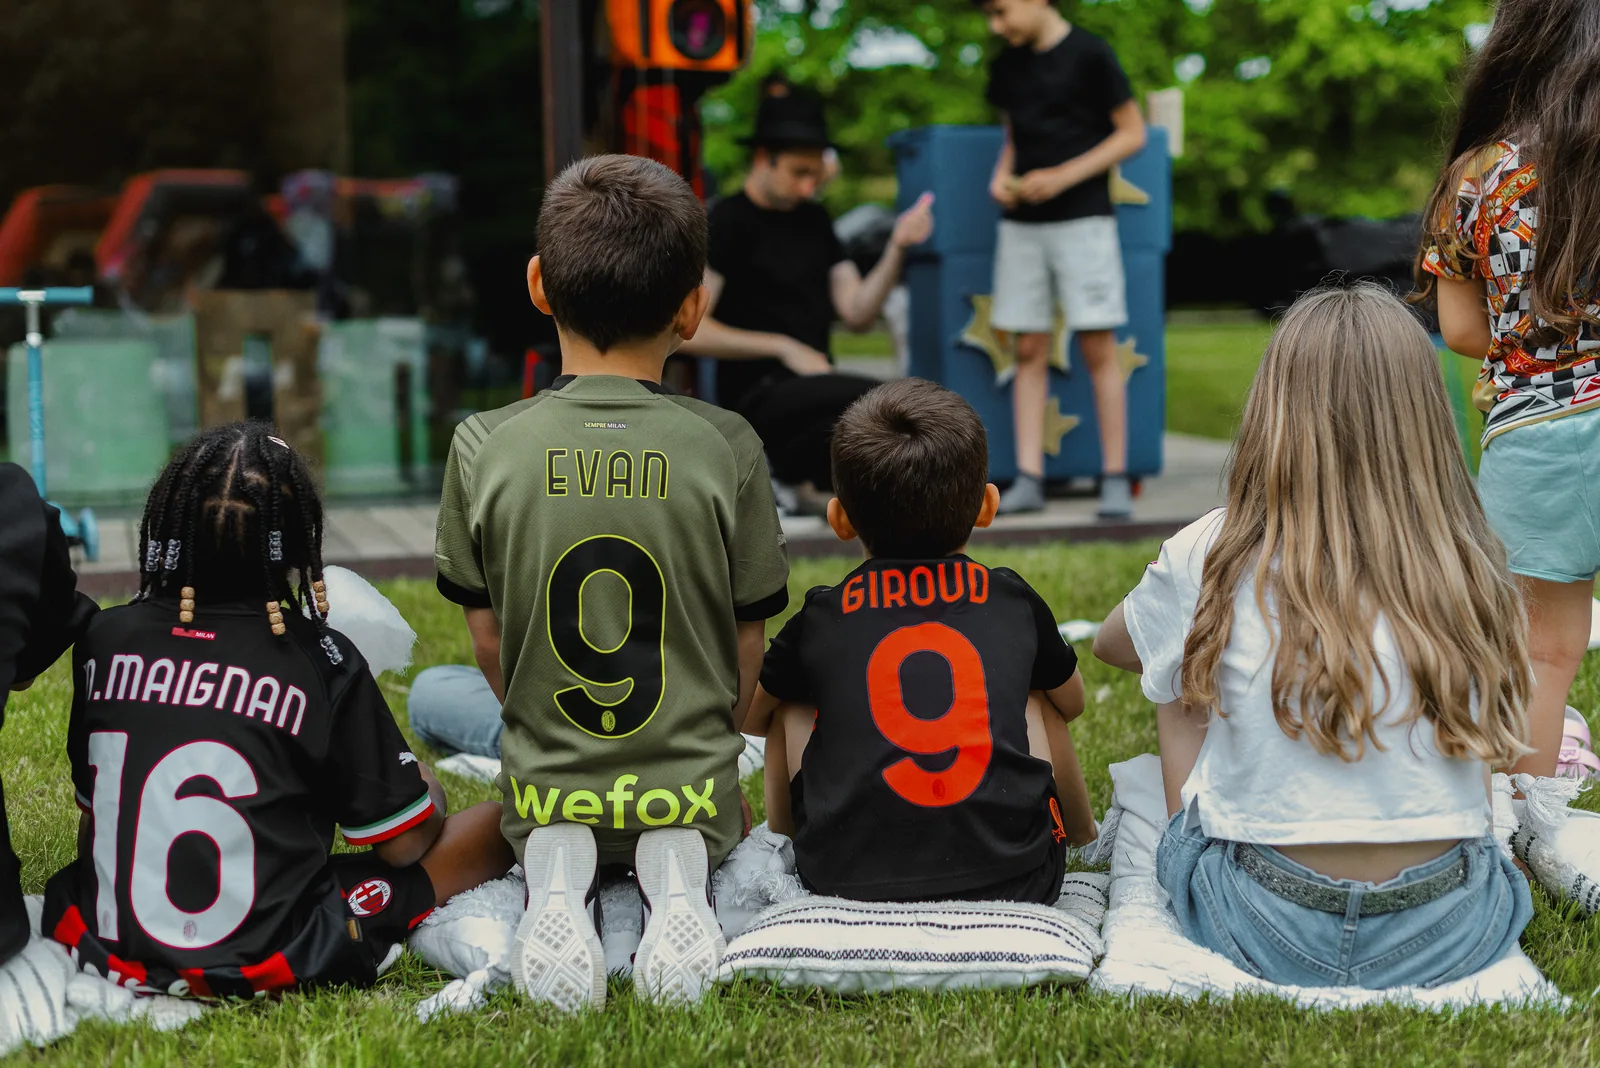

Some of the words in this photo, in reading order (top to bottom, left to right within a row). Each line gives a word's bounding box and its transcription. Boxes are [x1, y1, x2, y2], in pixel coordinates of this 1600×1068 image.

[546, 448, 669, 499] EVAN
[546, 534, 667, 739] 9
[841, 561, 989, 614] GIROUD
[866, 621, 993, 808] 9
[88, 730, 260, 950] 16
[509, 773, 718, 830] wefox
